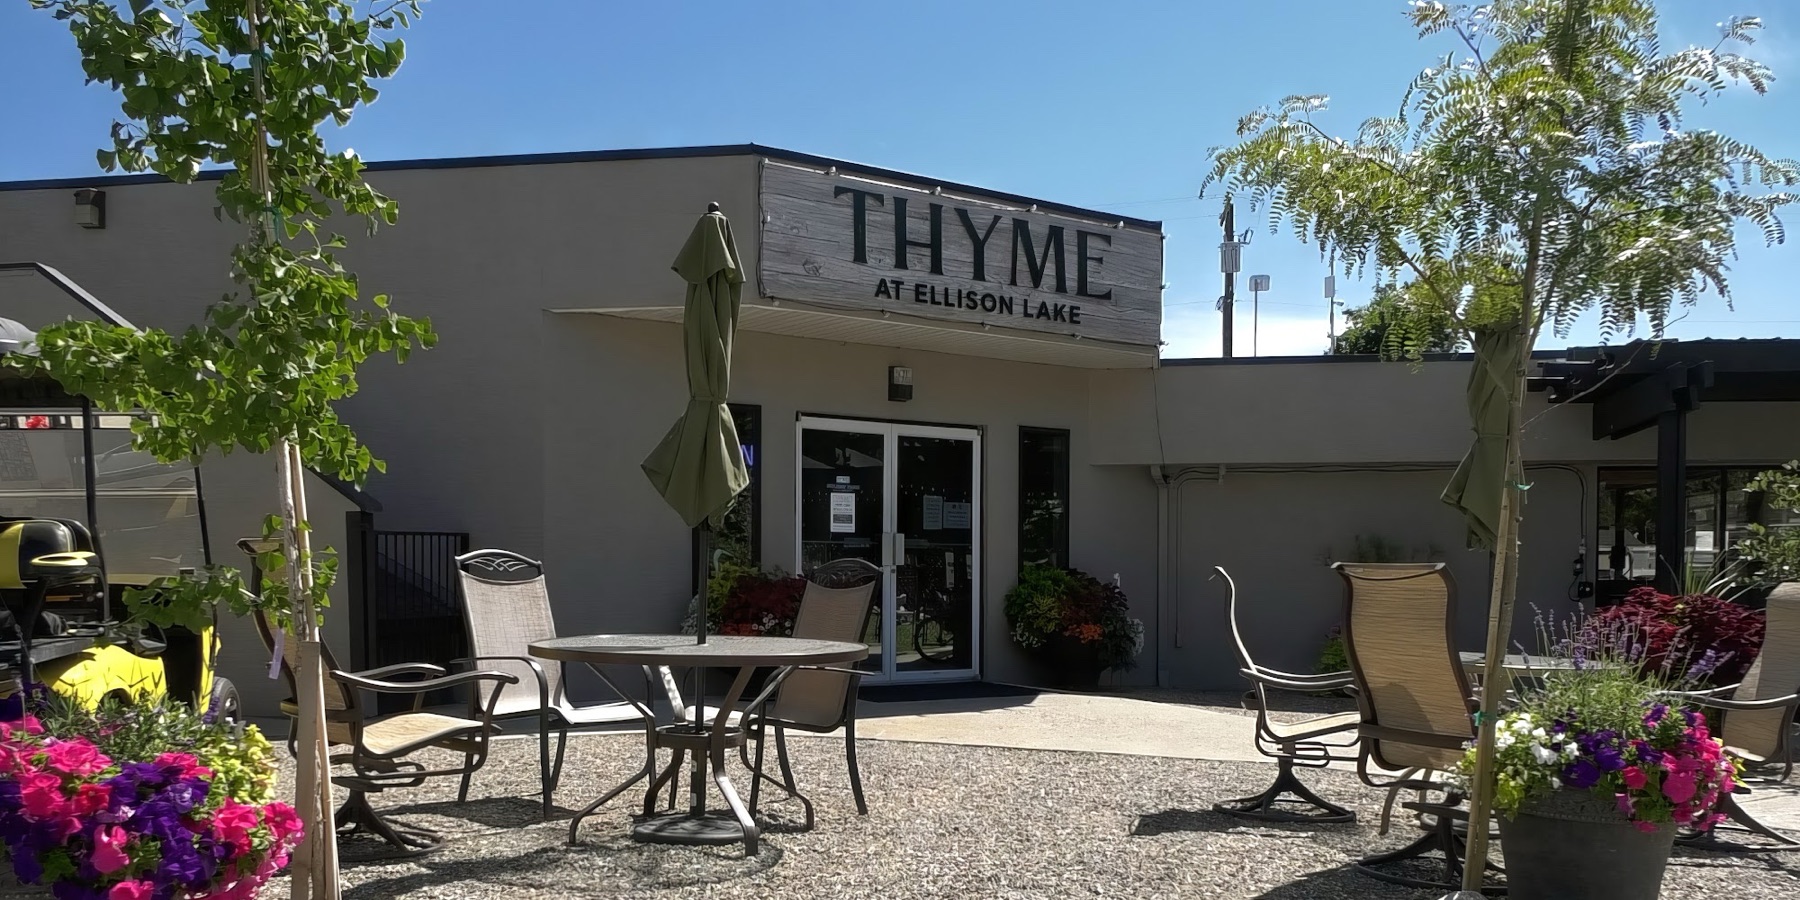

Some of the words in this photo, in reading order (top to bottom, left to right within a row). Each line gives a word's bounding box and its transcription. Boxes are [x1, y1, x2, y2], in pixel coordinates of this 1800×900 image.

[834, 186, 1112, 299] THYME
[875, 278, 904, 300] AT
[915, 284, 1013, 315] ELLISON
[1023, 298, 1081, 324] LAKE
